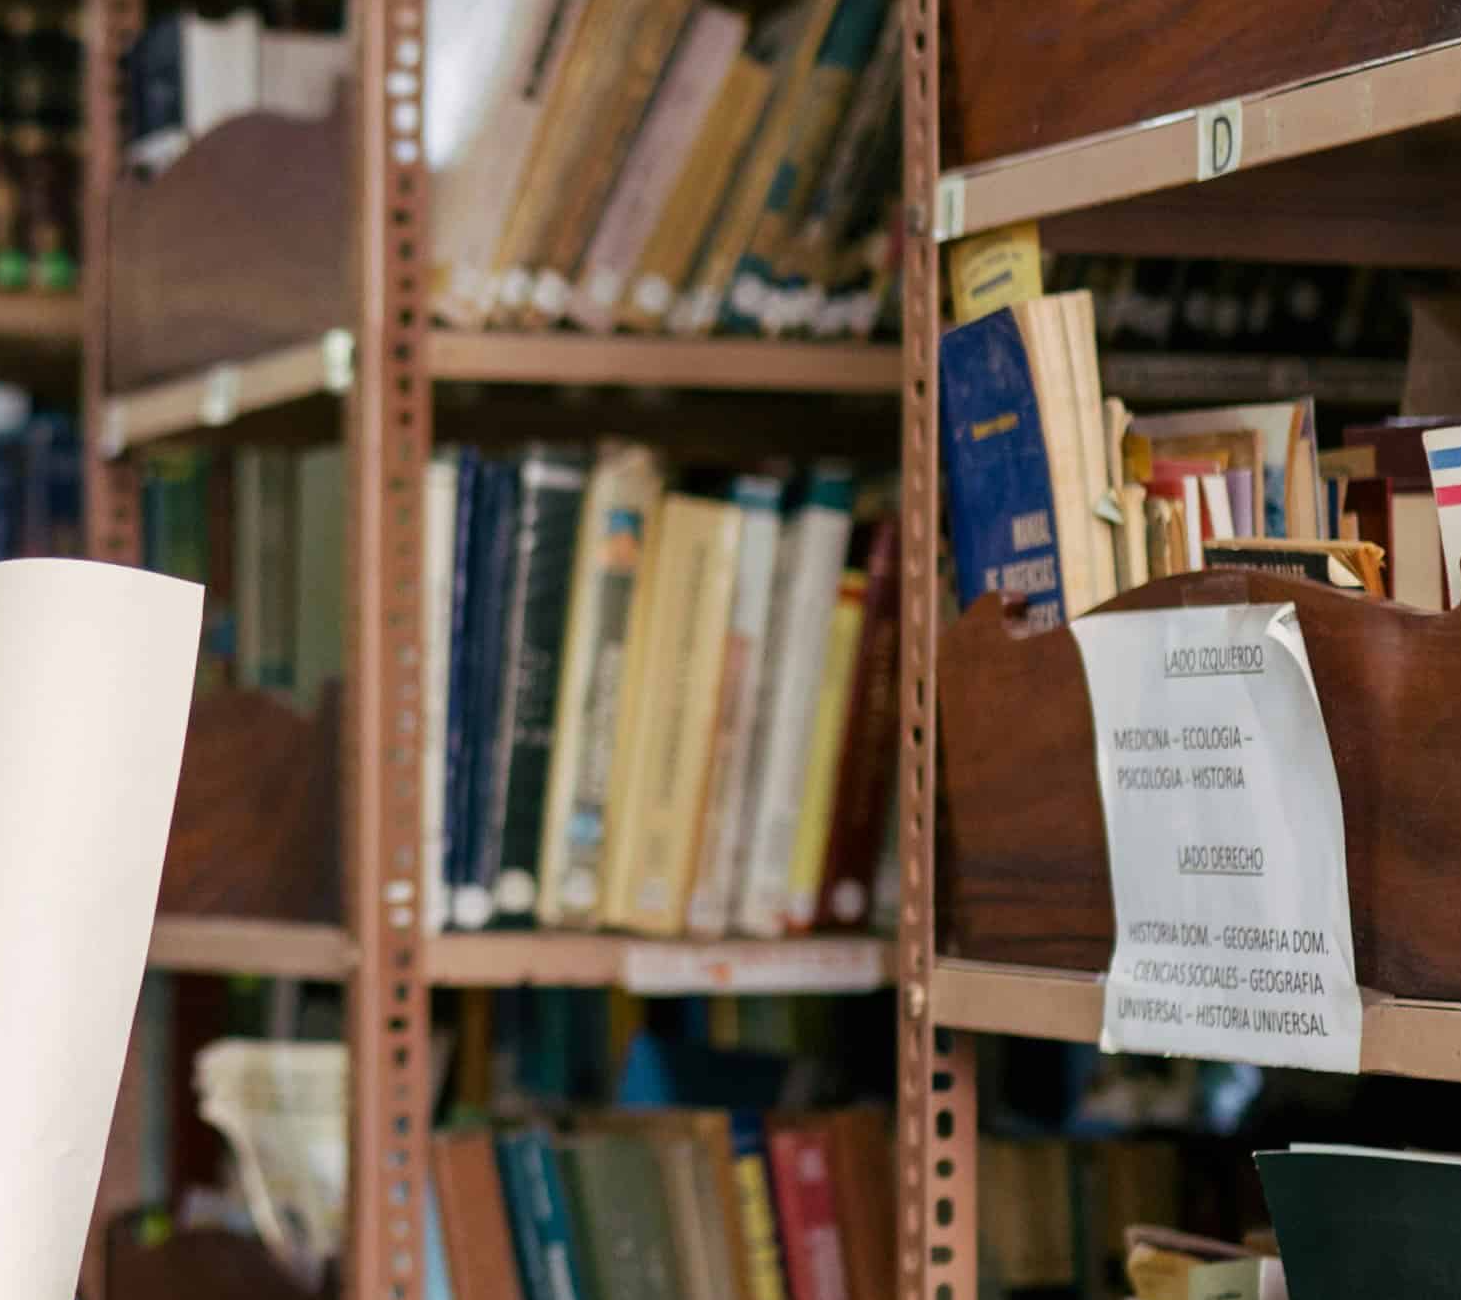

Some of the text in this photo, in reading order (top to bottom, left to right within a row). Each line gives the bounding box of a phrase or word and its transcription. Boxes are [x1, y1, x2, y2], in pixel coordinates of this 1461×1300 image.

[1212, 117, 1233, 173] D
[1164, 646, 1264, 673] LADO IZQUIERDO
[1114, 727, 1241, 750] MEDICINA ECOLOGIA
[1117, 767, 1245, 790] PSICOLOGIA HISTORIA
[1178, 847, 1264, 871] LADO DERECHO
[1129, 923, 1330, 956] HISTORIA DOM. GEOGRAFIA DOM.
[1133, 959, 1325, 994] CIENCIAS SOCIALES GEOGRAFIA
[1118, 998, 1329, 1036] UNIVERSAL HISTORIA UNIVERSAL
